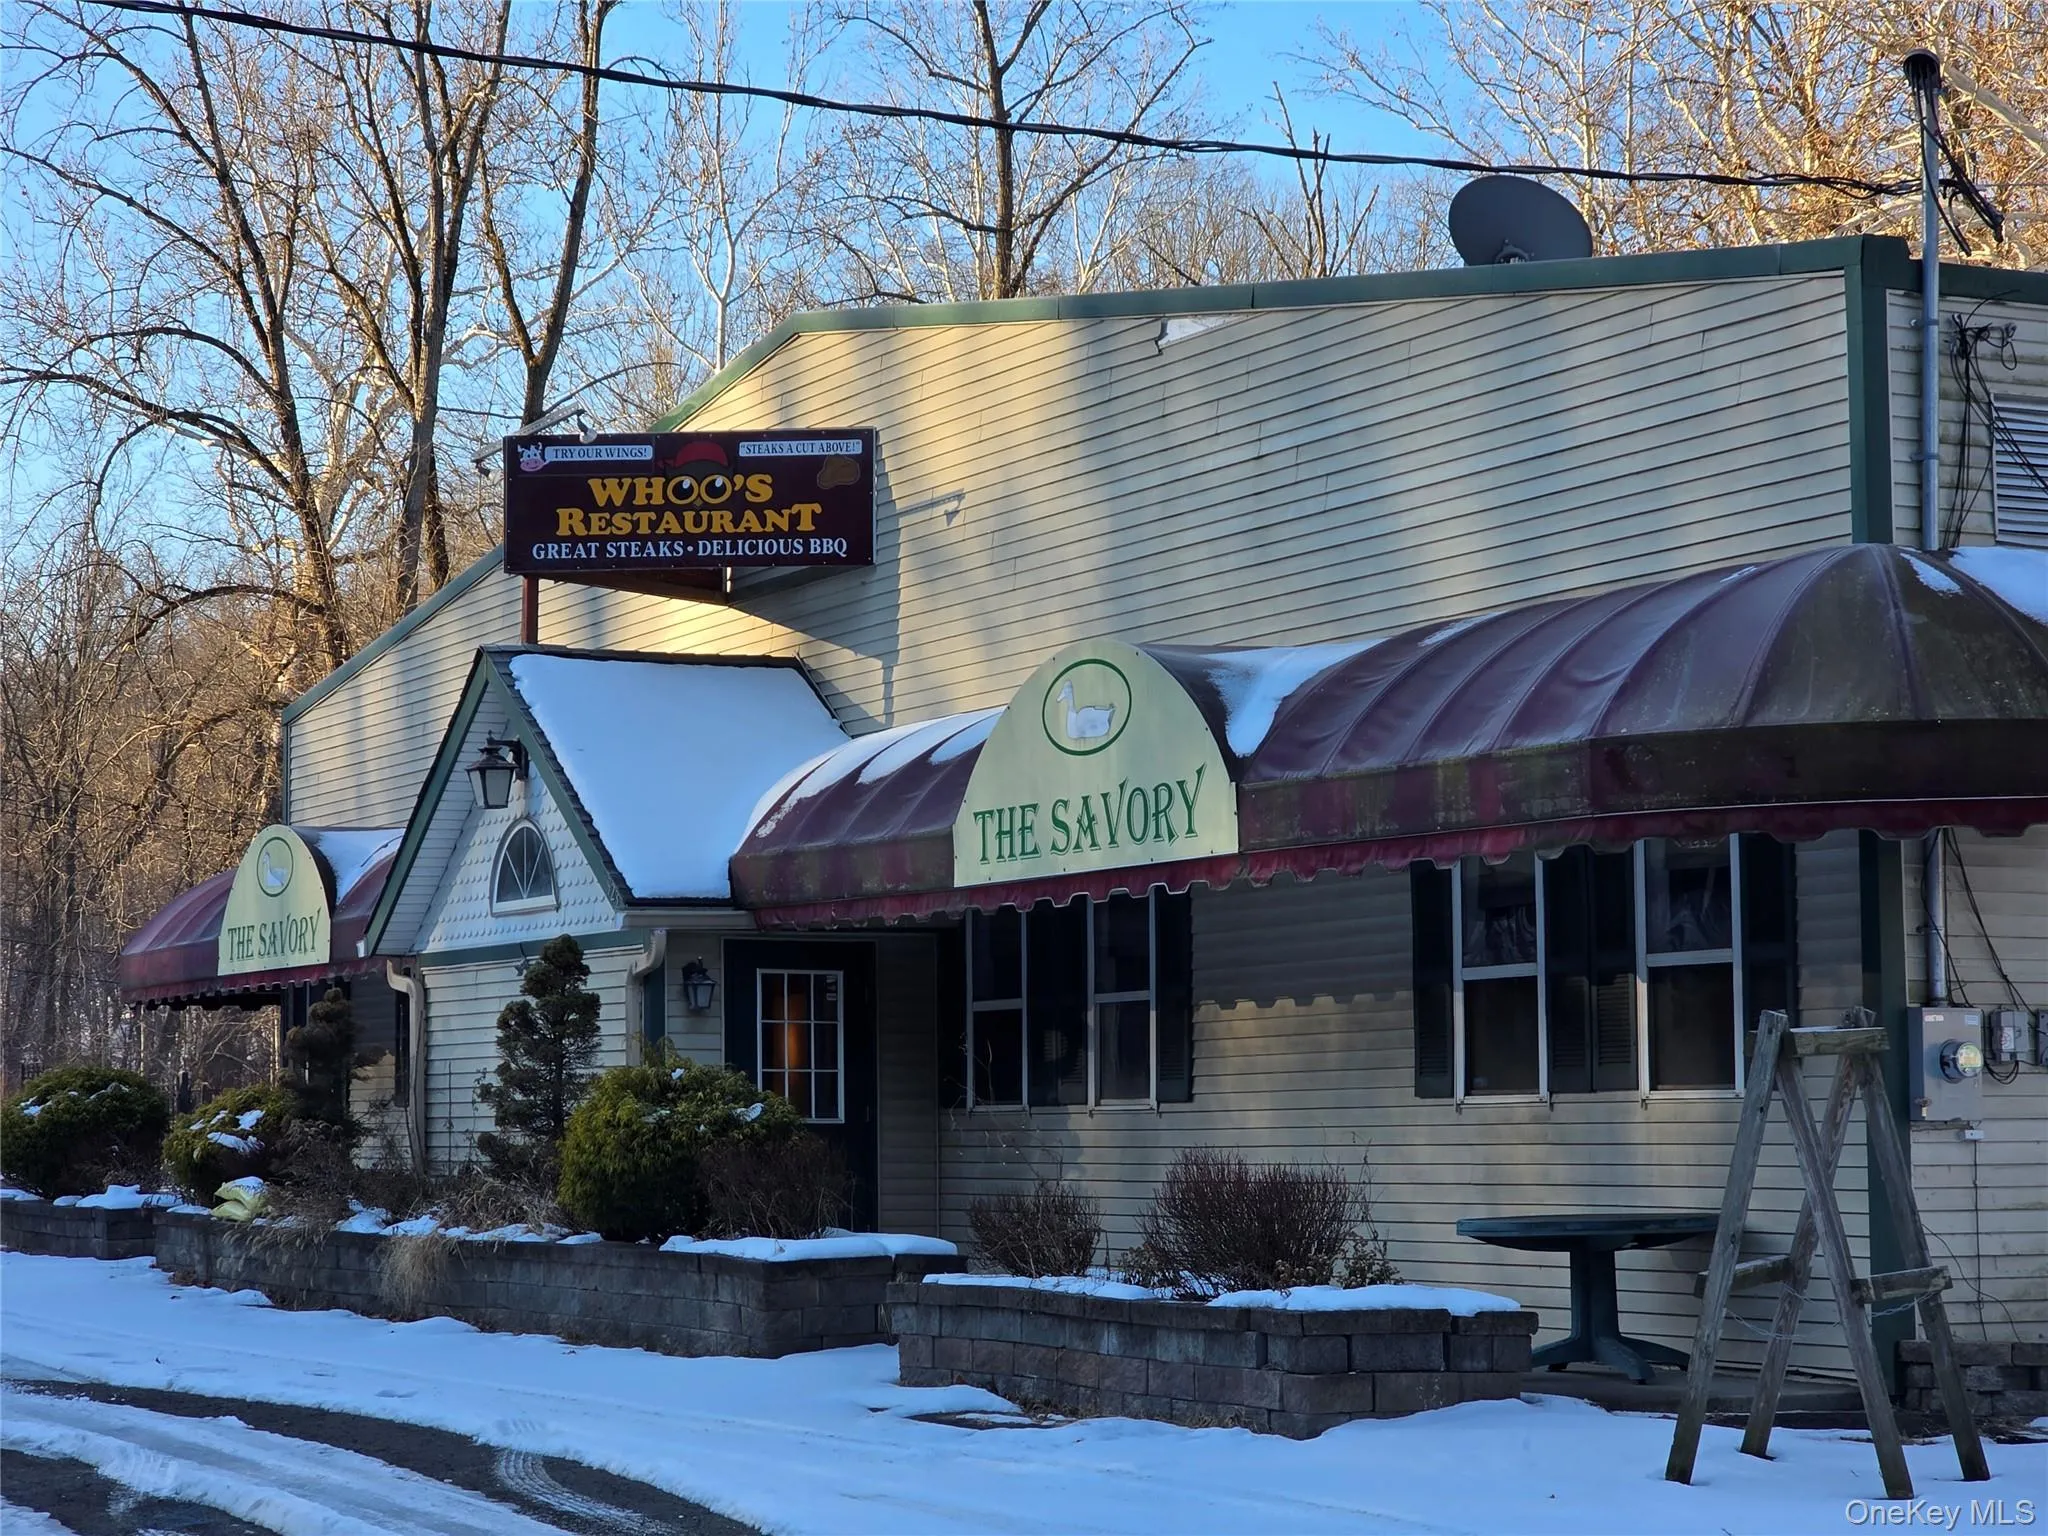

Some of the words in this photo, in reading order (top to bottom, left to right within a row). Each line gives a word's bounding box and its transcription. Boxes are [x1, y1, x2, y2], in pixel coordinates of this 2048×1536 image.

[552, 447, 577, 459] TRY
[577, 447, 603, 459] OUR
[604, 446, 647, 458] WINGS!
[786, 443, 794, 454] A
[795, 442, 815, 454] CUT
[587, 473, 774, 508] WHOO'S
[555, 502, 823, 537] RESTAURANT
[532, 542, 600, 560] GREAT
[606, 540, 684, 559] STEAKS
[697, 538, 804, 557] DELICIOUS
[809, 537, 848, 557] BBQ
[973, 802, 1041, 866] THE
[1049, 762, 1207, 857] SAVORY
[227, 924, 255, 962] THE
[258, 906, 322, 958] SAVORY
